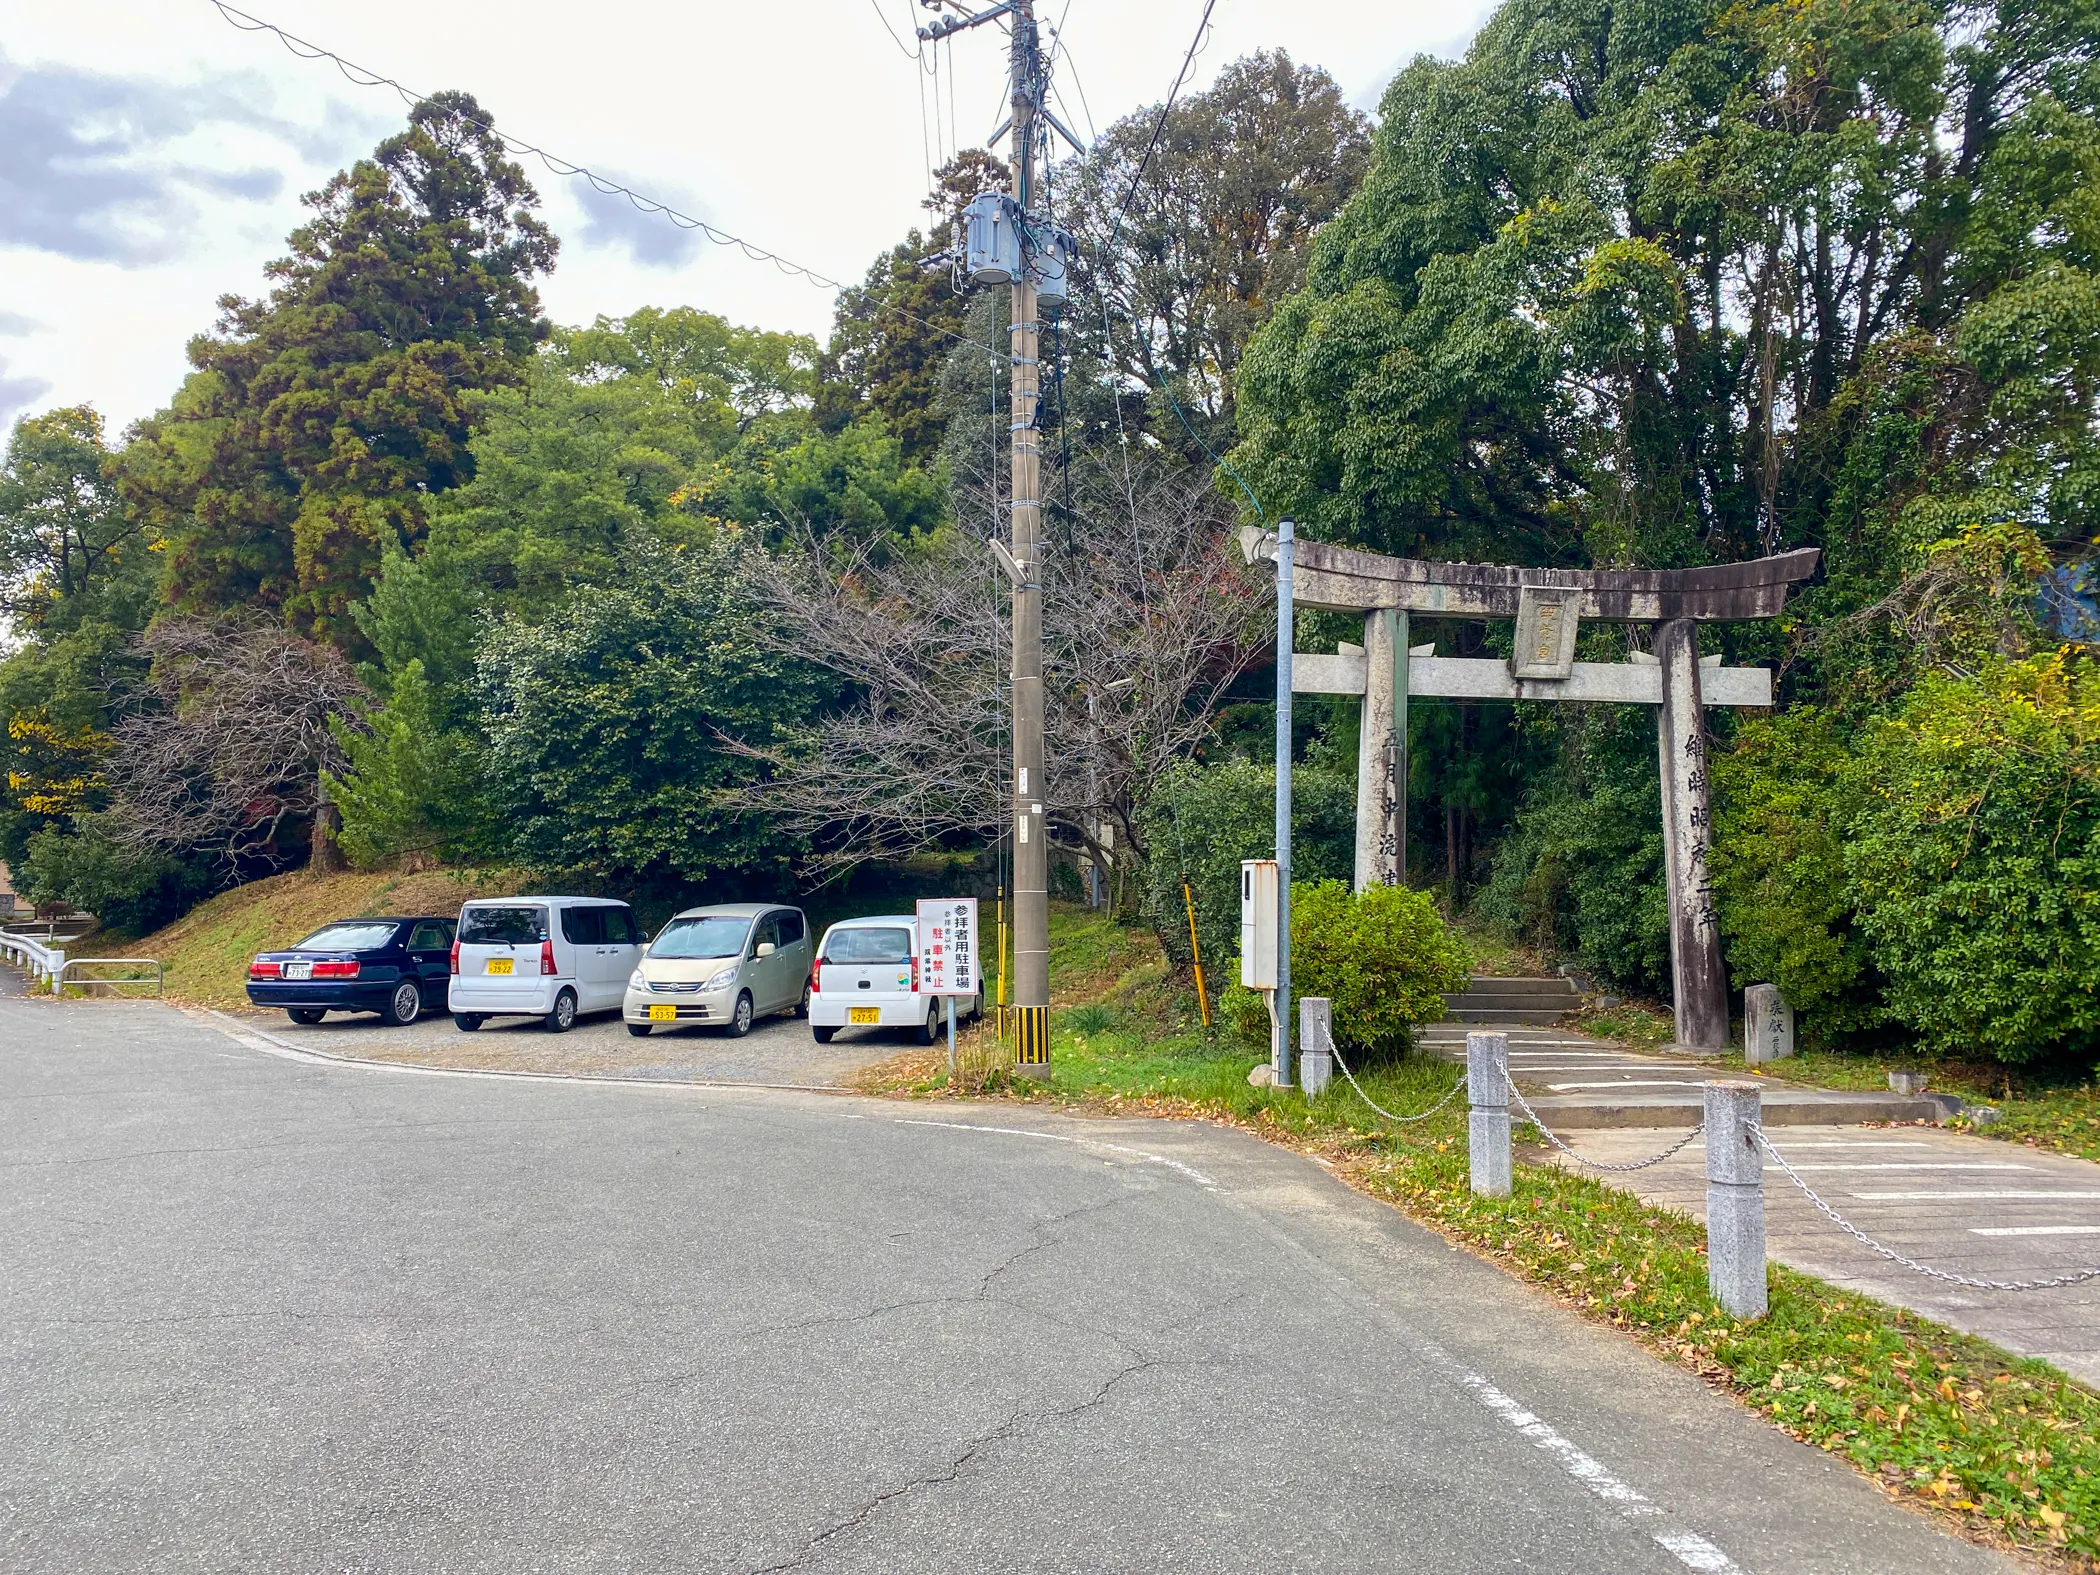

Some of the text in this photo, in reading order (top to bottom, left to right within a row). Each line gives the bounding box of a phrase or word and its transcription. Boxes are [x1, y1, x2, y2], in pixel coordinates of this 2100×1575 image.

[944, 910, 952, 951] 参拝者以外
[954, 905, 969, 988] 参拝者用駐車場
[932, 928, 944, 988] 駐車禁止
[655, 1011, 674, 1019] 53-57
[857, 1014, 876, 1022] 27-51
